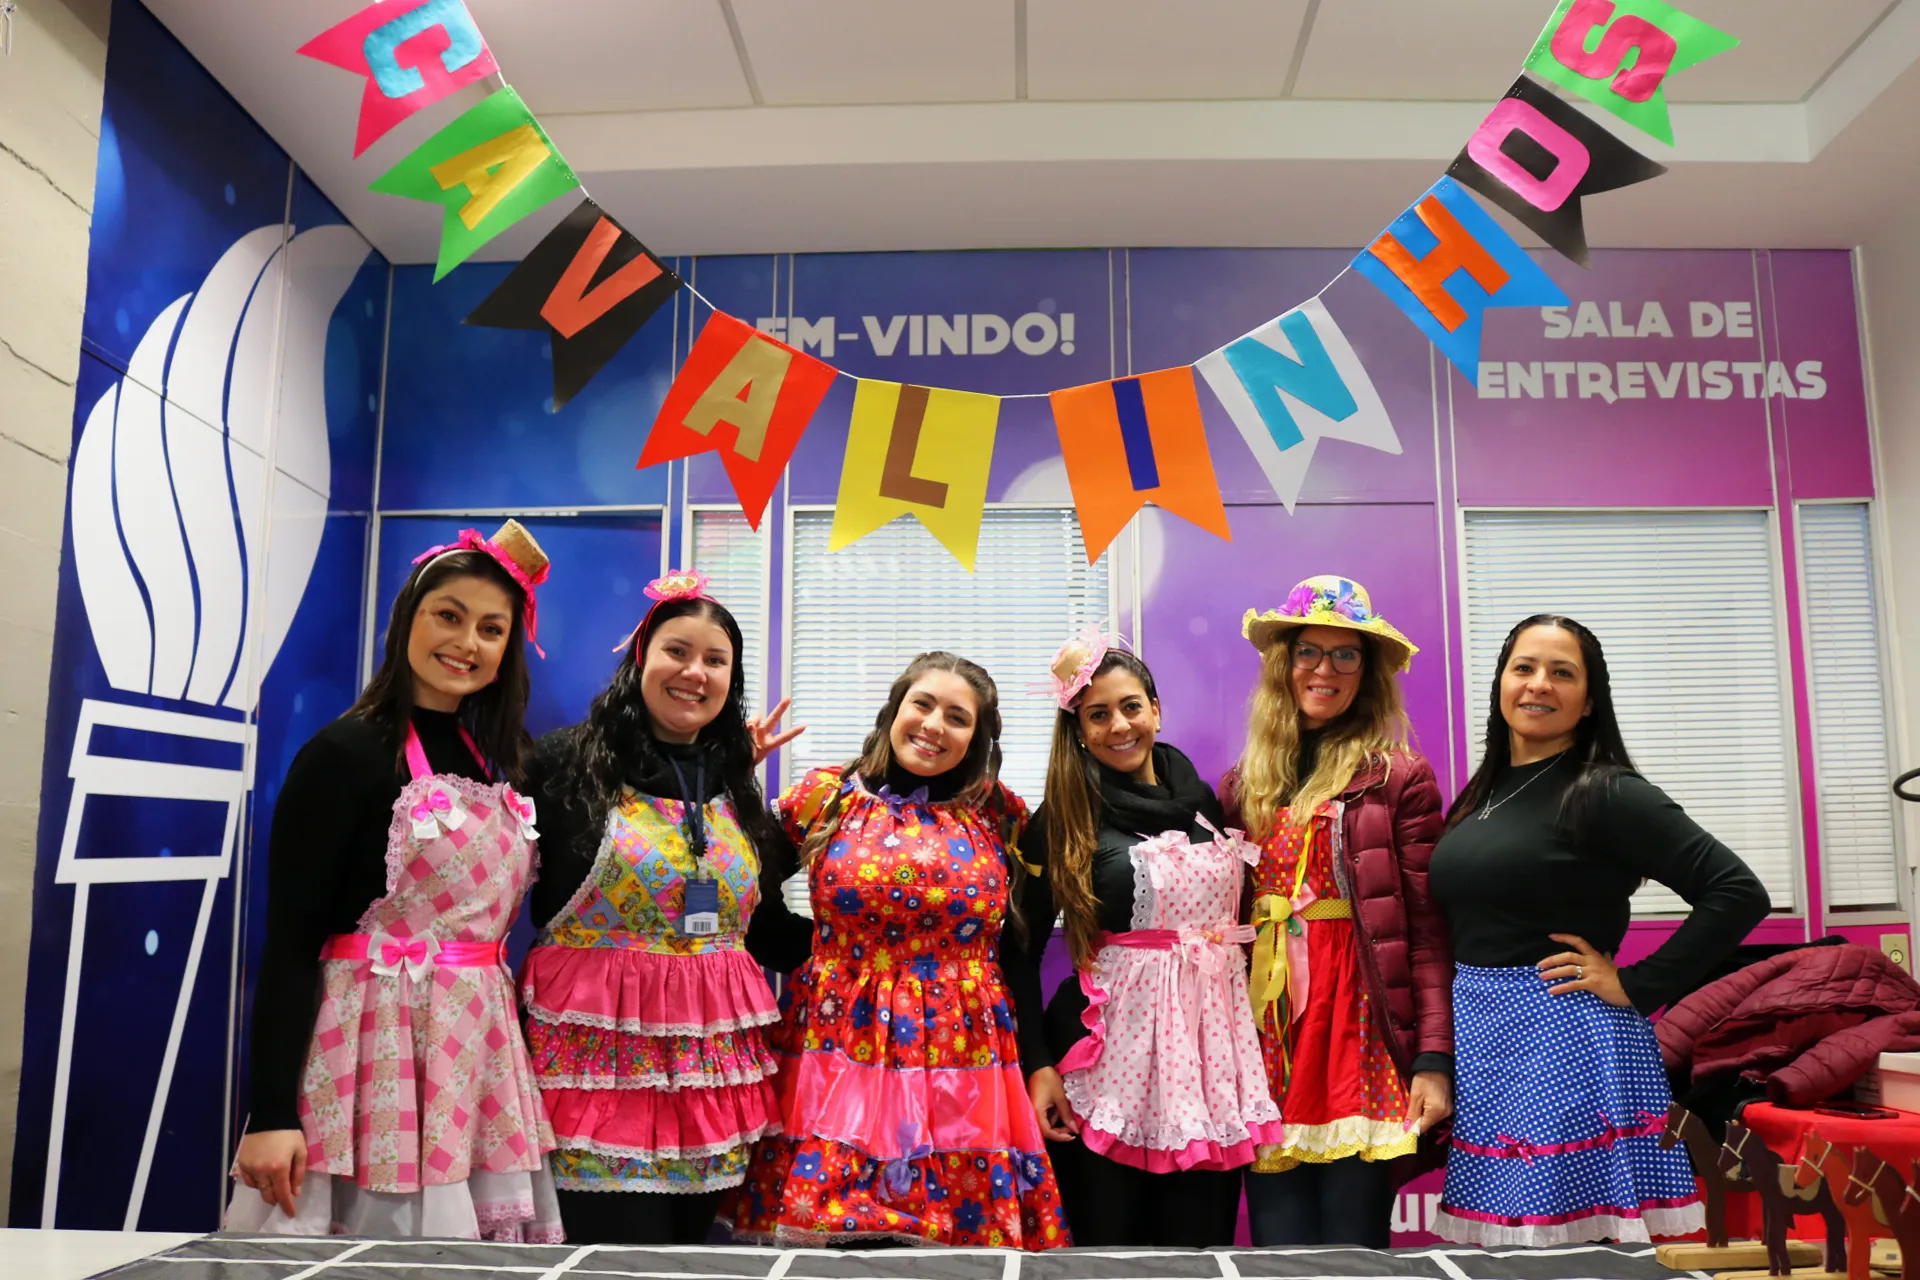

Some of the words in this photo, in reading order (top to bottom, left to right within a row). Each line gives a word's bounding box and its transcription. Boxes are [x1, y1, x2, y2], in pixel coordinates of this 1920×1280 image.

[362, 0, 1677, 509] CAVALINHOS
[736, 312, 1075, 357] EM-VINDO!
[1541, 301, 1672, 338] SALA
[1689, 302, 1753, 337] DE
[1476, 360, 1827, 404] ENTREVISTAS
